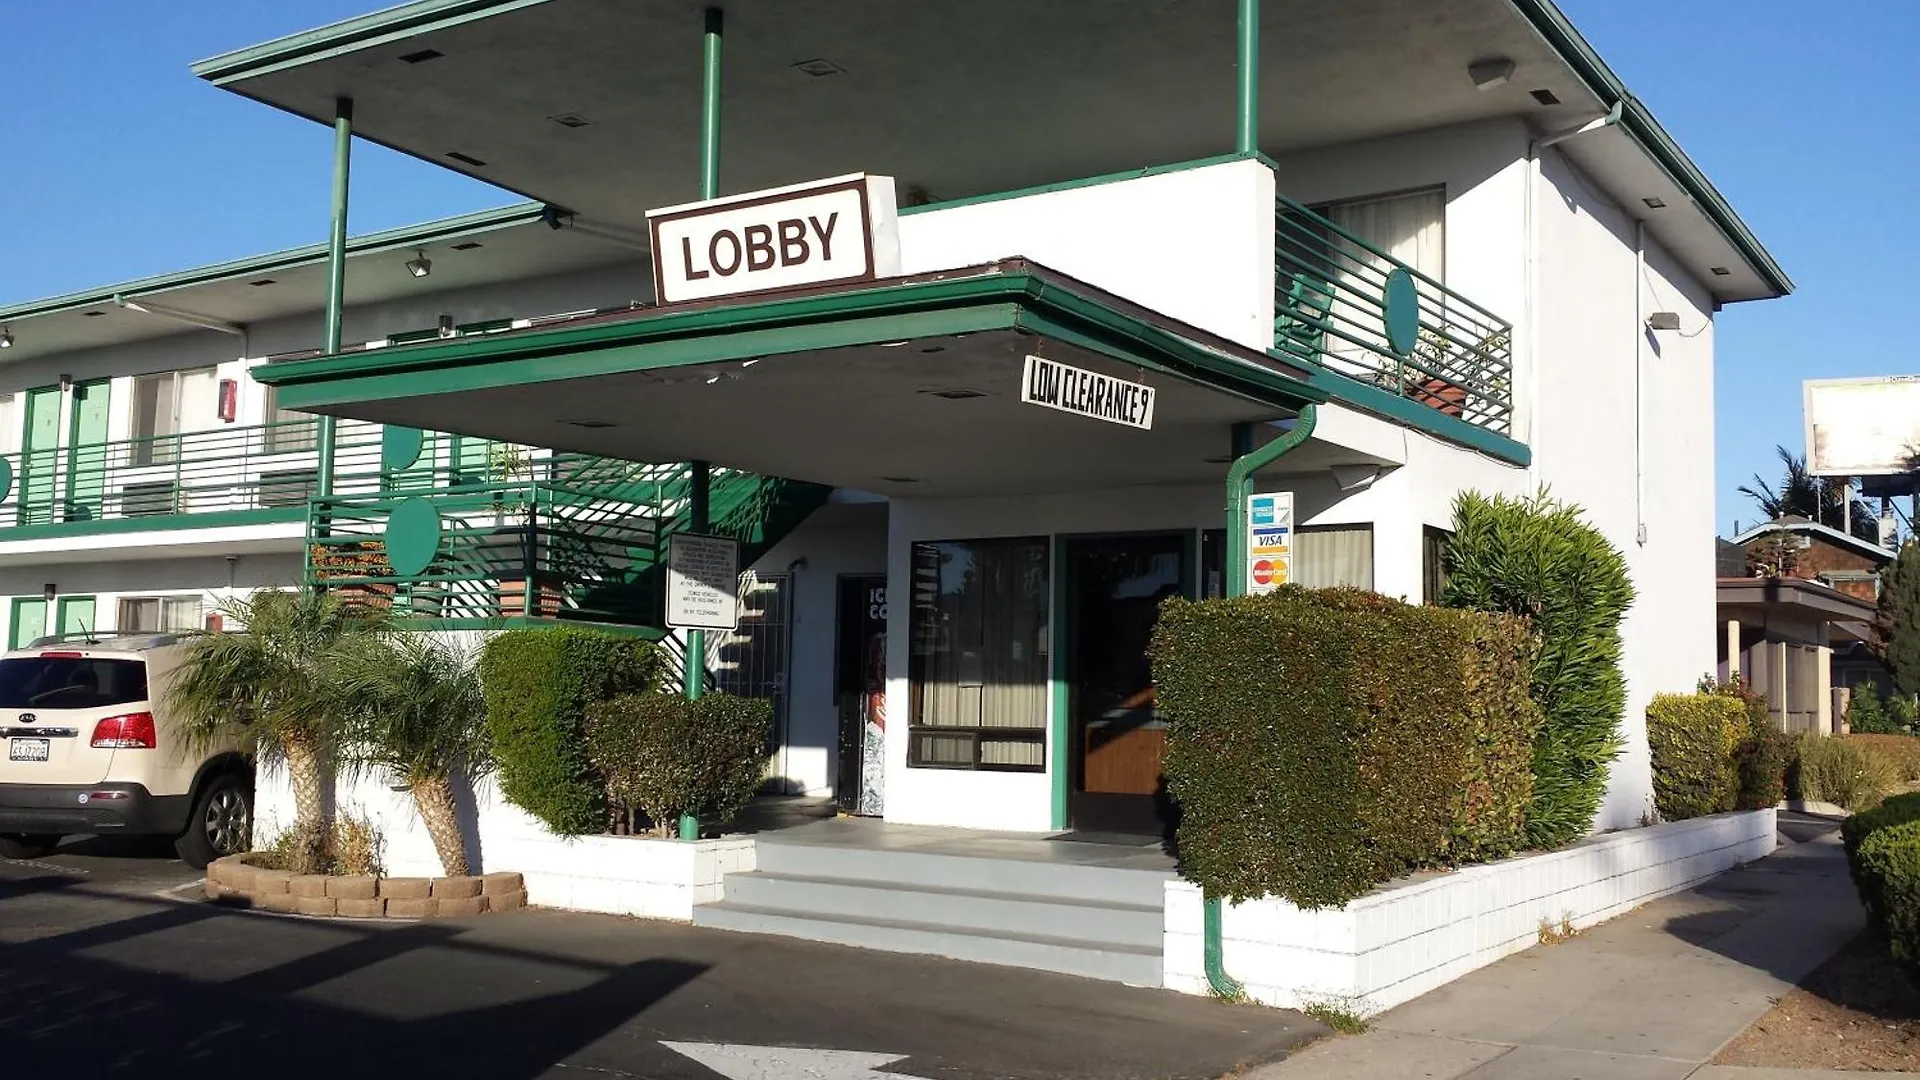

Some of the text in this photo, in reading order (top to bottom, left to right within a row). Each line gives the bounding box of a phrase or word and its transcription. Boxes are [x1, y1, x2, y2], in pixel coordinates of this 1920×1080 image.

[682, 211, 839, 281] LOBBY
[1029, 359, 1060, 406] LOW
[1062, 368, 1140, 424] CLEARANCE
[1259, 535, 1282, 546] VISA
